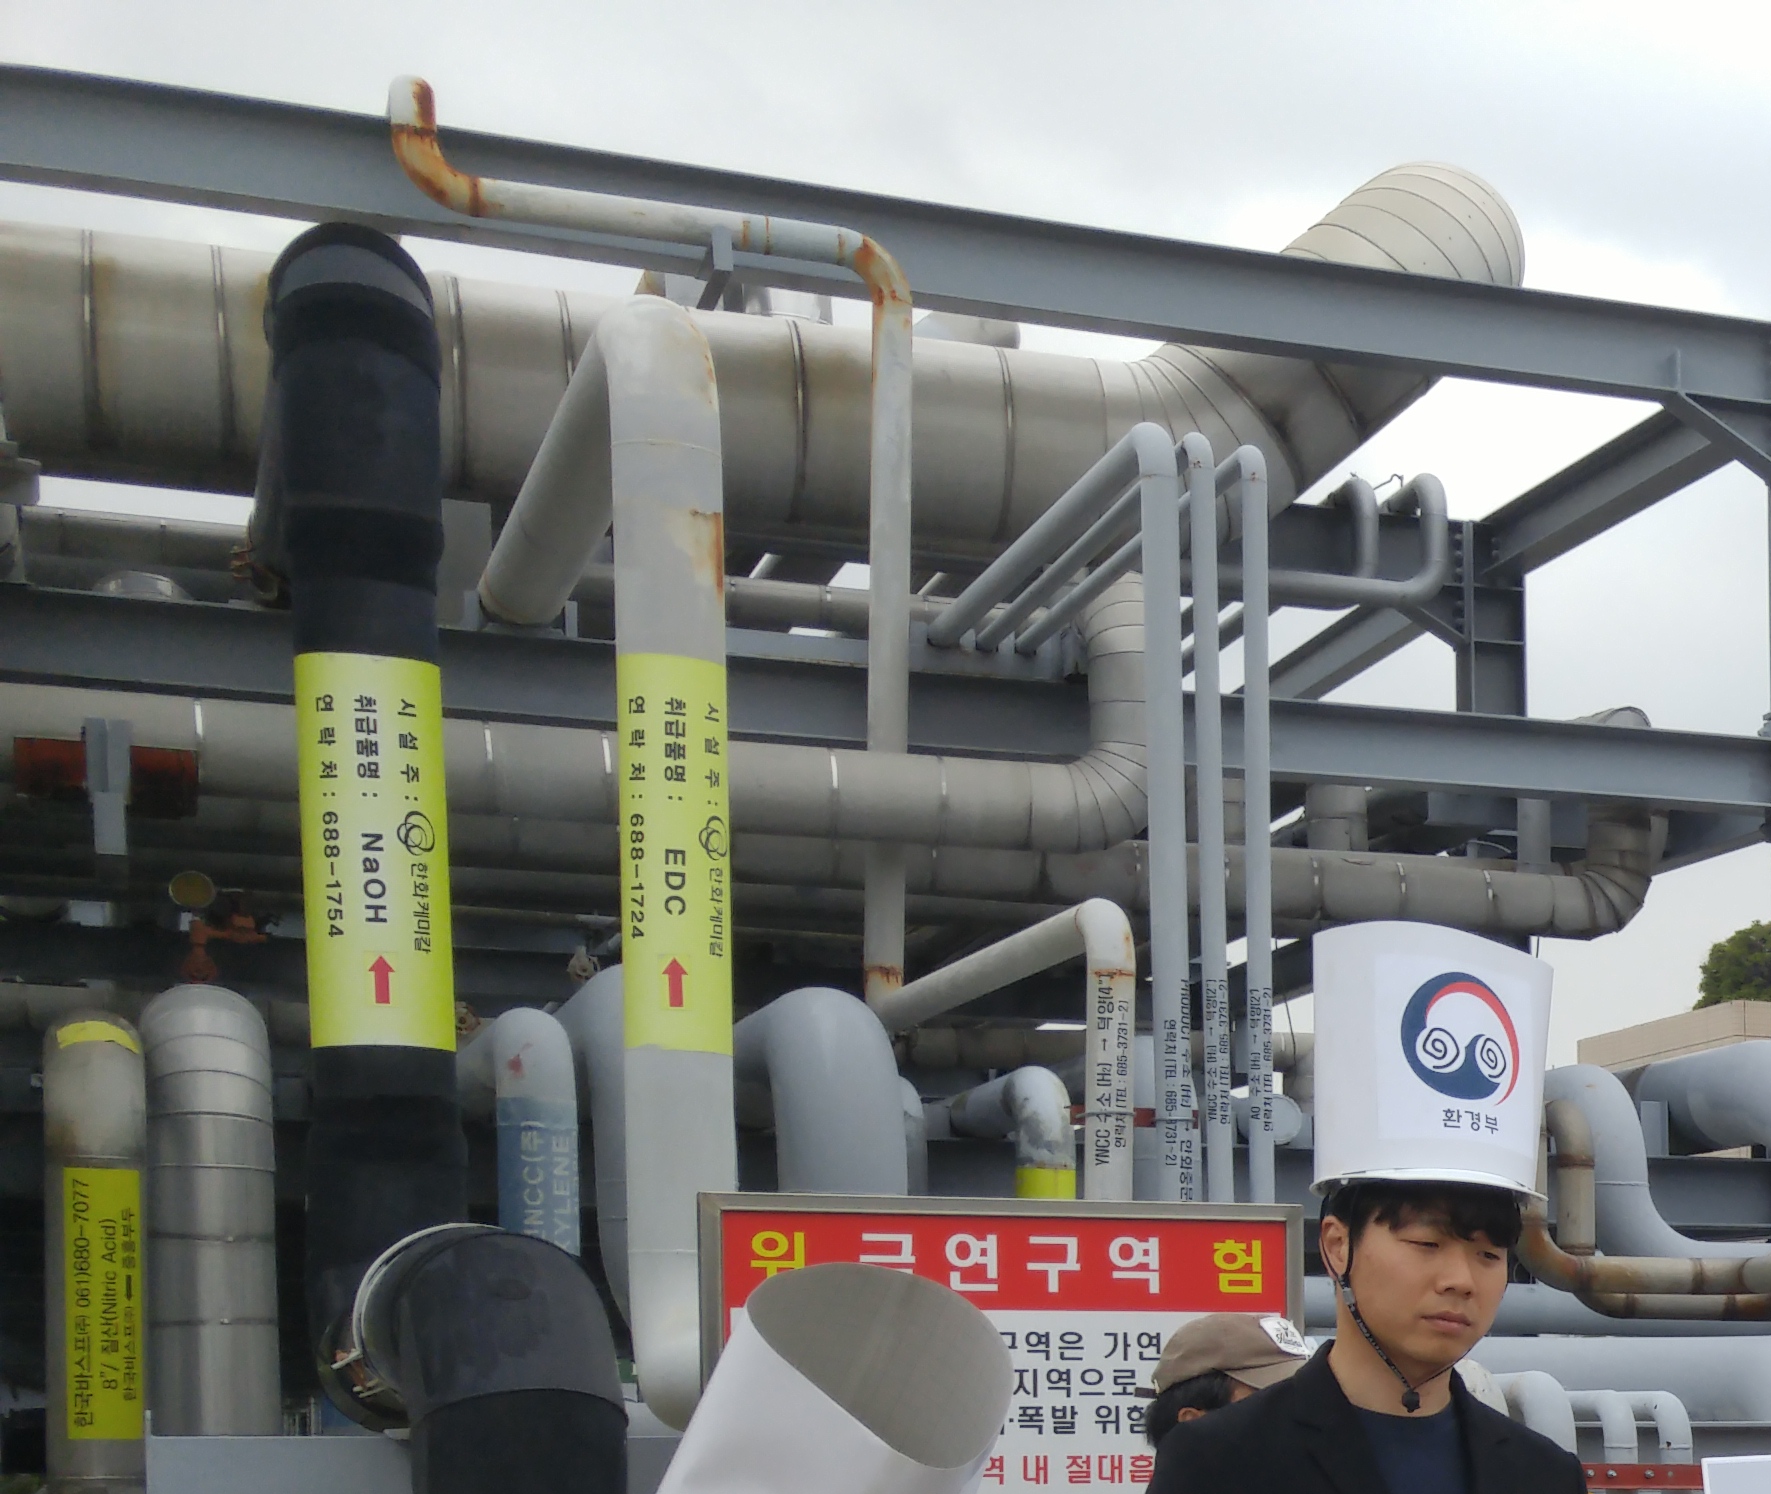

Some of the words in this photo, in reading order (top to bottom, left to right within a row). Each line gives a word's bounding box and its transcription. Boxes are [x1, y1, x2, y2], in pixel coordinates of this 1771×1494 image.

[322, 810, 344, 938] 688-1754
[361, 832, 387, 924] NaOH
[630, 813, 645, 939] 688-1724
[664, 847, 687, 917] EDC
[410, 862, 431, 954] 한화케미칼
[1208, 1094, 1217, 1121] YNCC
[1442, 1108, 1499, 1134] 환경부
[1095, 1129, 1110, 1166] YNCC
[98, 1218, 117, 1264] Acid)
[1022, 1455, 1048, 1485] 내
